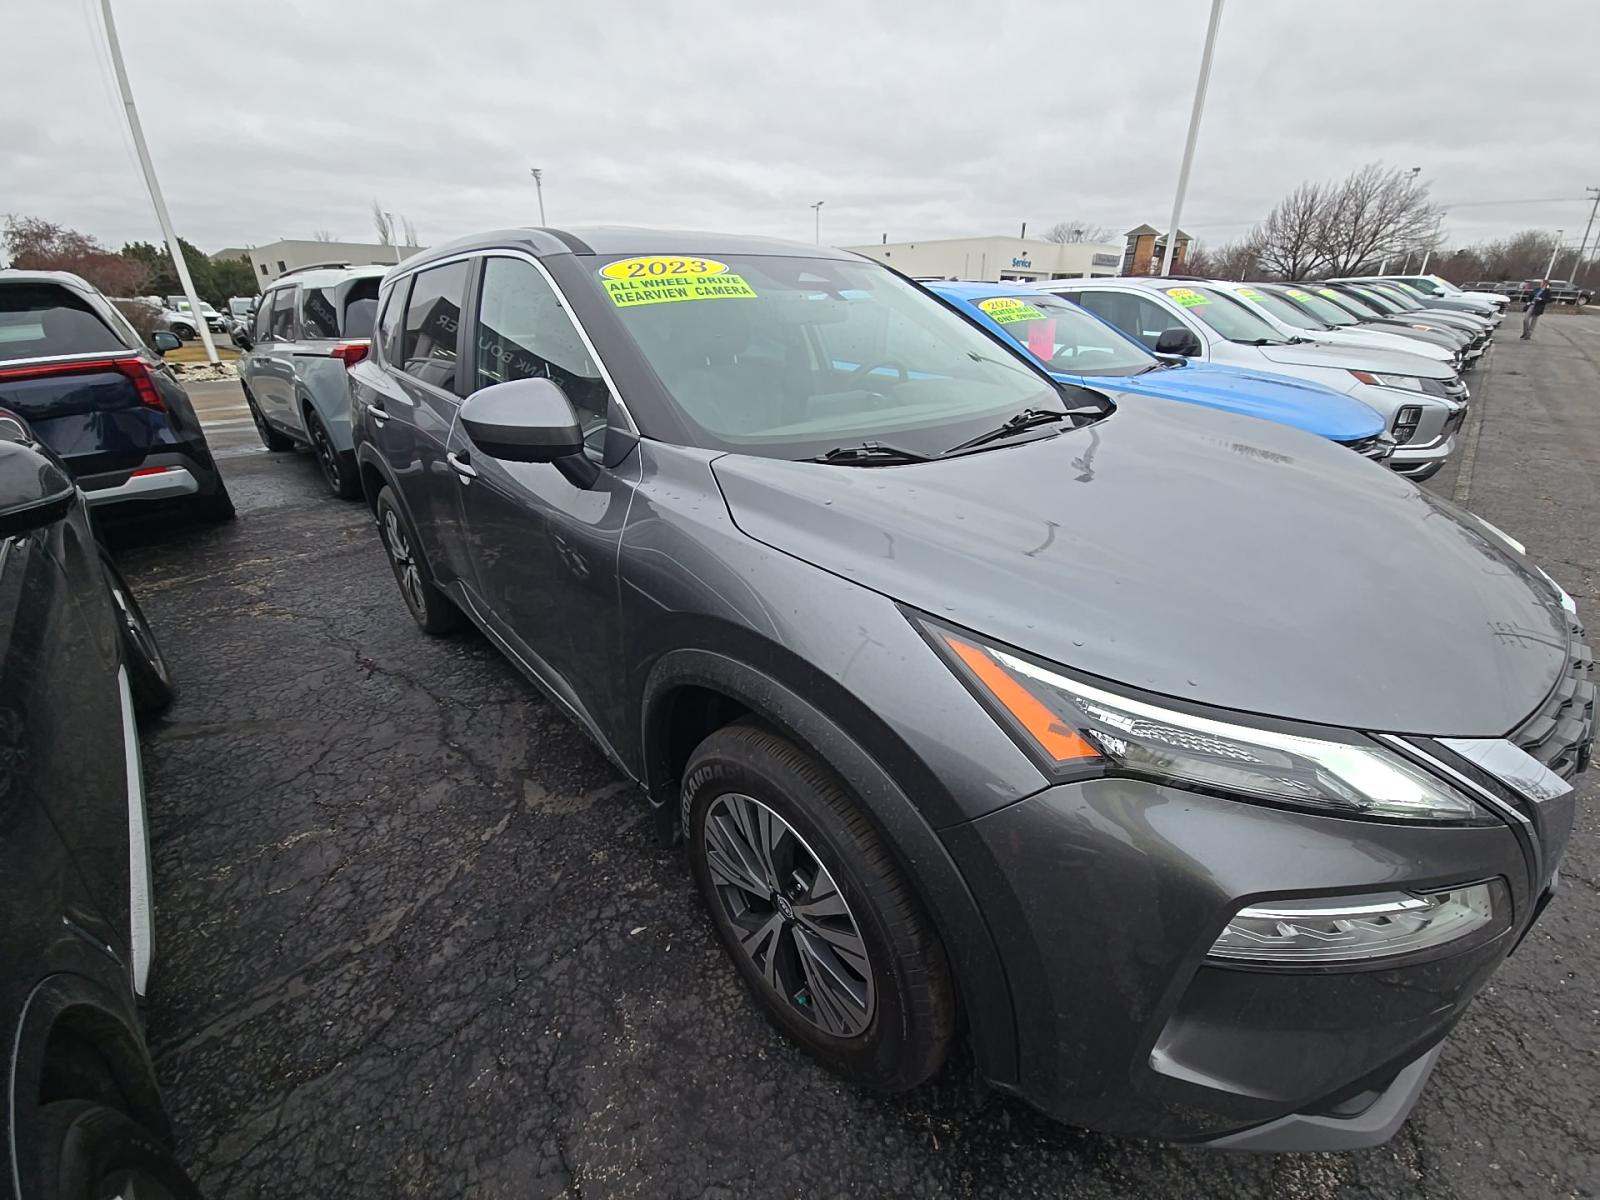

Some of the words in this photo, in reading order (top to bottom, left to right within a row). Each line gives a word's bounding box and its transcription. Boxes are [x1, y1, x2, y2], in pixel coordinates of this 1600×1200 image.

[627, 260, 708, 278] 2023
[1012, 257, 1032, 269] Service
[610, 281, 638, 292] ALL
[640, 278, 692, 288] WHEEL
[697, 276, 740, 284] DRIVE
[614, 287, 688, 304] REARVIEW
[695, 286, 751, 296] CAMERA
